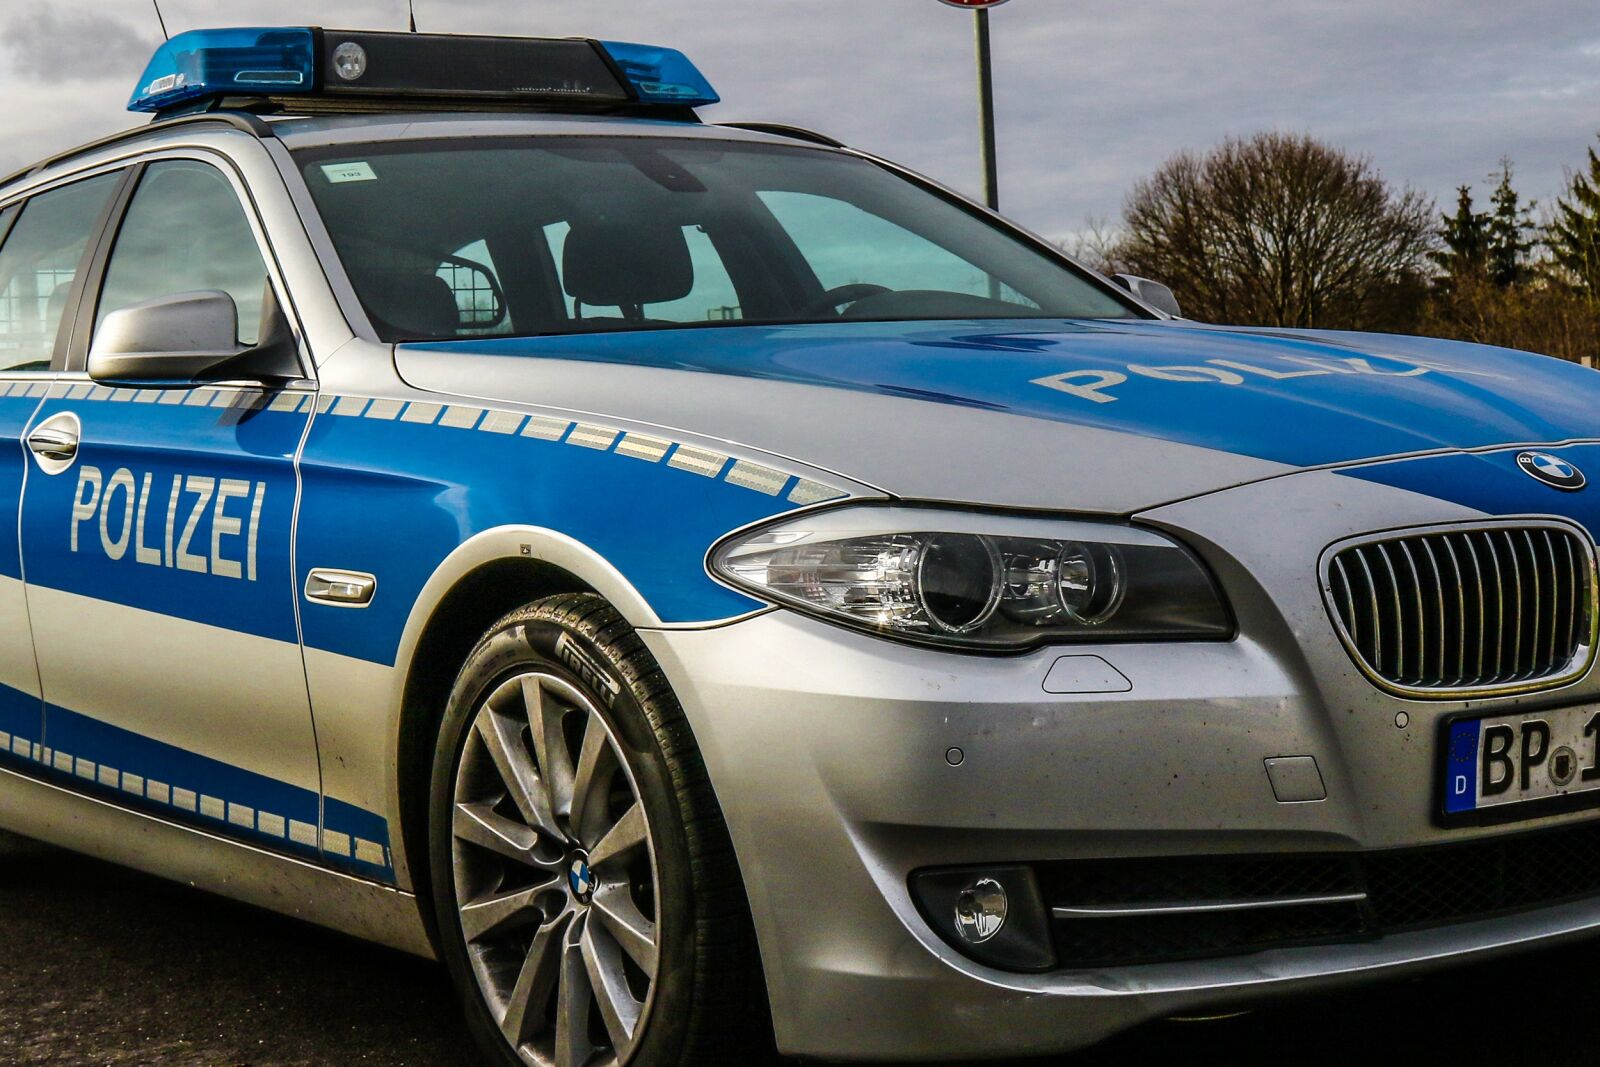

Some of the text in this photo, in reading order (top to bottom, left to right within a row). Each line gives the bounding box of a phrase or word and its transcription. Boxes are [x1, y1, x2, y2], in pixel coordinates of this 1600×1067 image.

[71, 465, 266, 581] POLIZEI
[1455, 775, 1467, 794] D
[1482, 723, 1550, 797] BP
